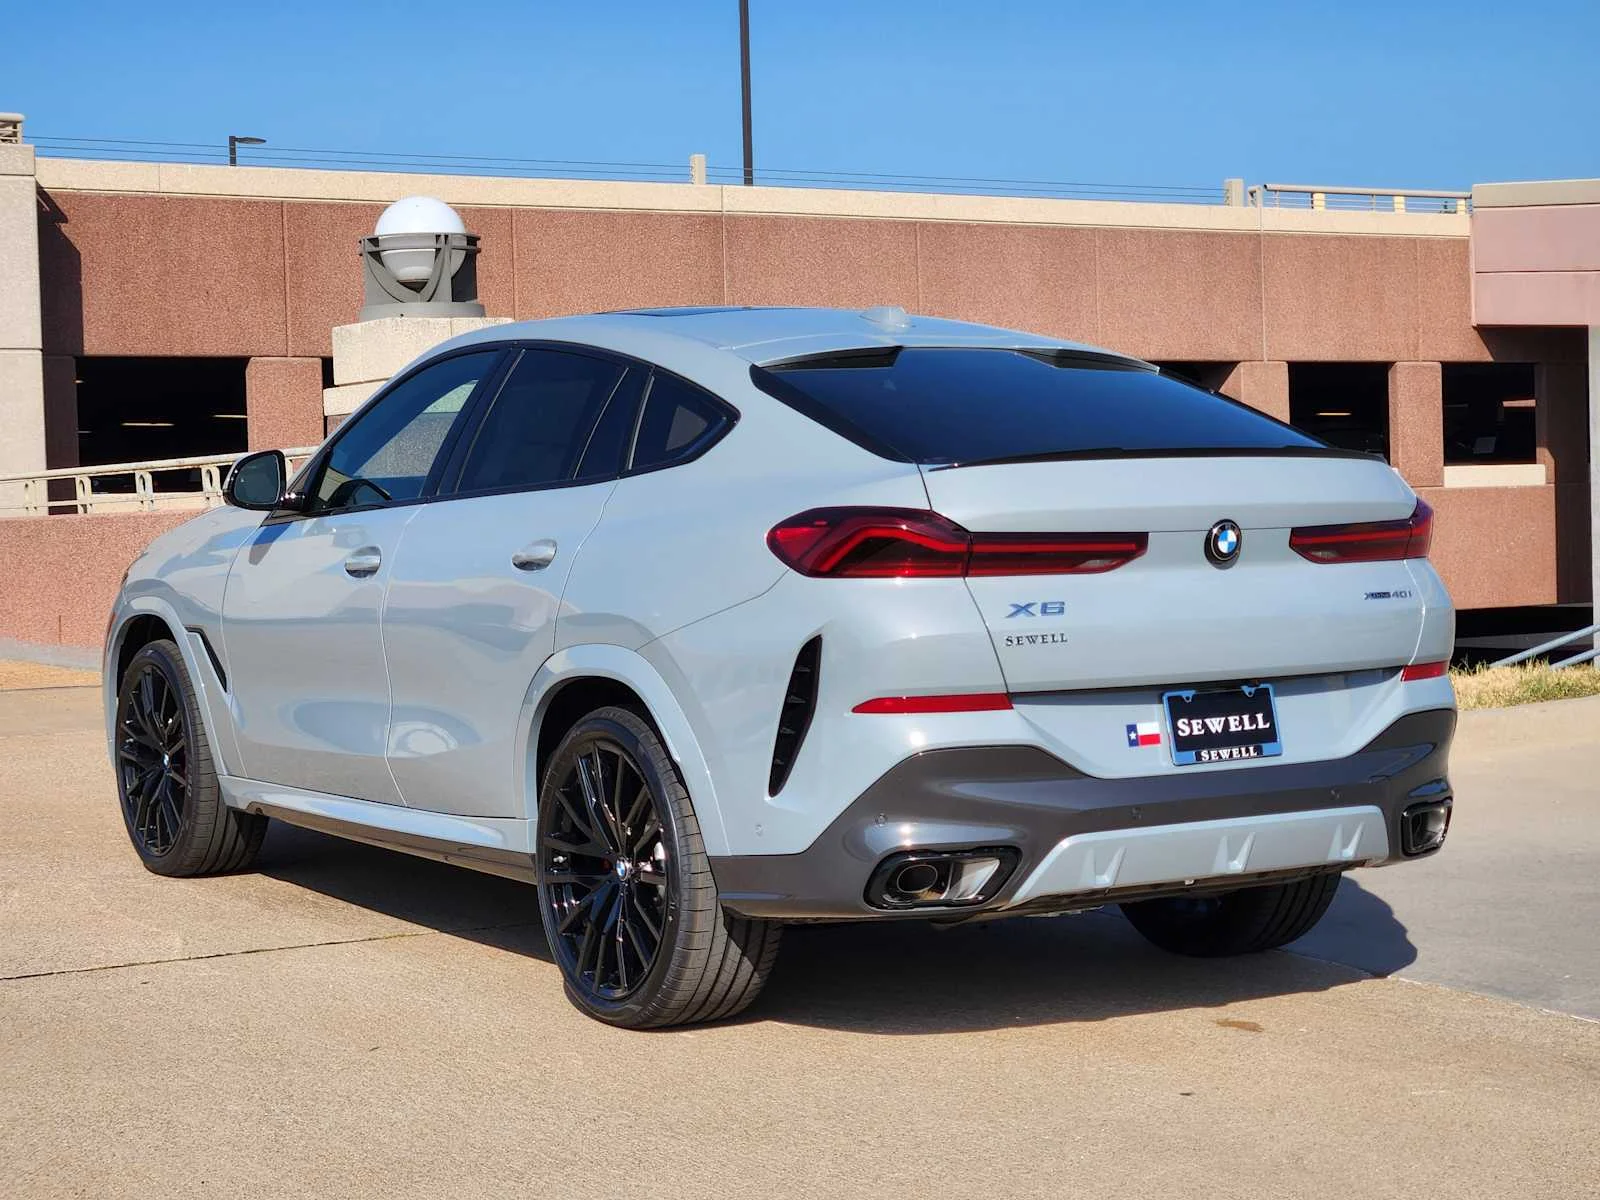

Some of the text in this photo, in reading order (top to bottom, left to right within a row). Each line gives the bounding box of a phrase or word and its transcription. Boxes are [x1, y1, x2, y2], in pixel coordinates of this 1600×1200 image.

[1005, 601, 1065, 618] X6
[1005, 633, 1068, 646] SEWELL
[1177, 713, 1270, 737] SEWELL
[1201, 746, 1258, 761] SEWELL
